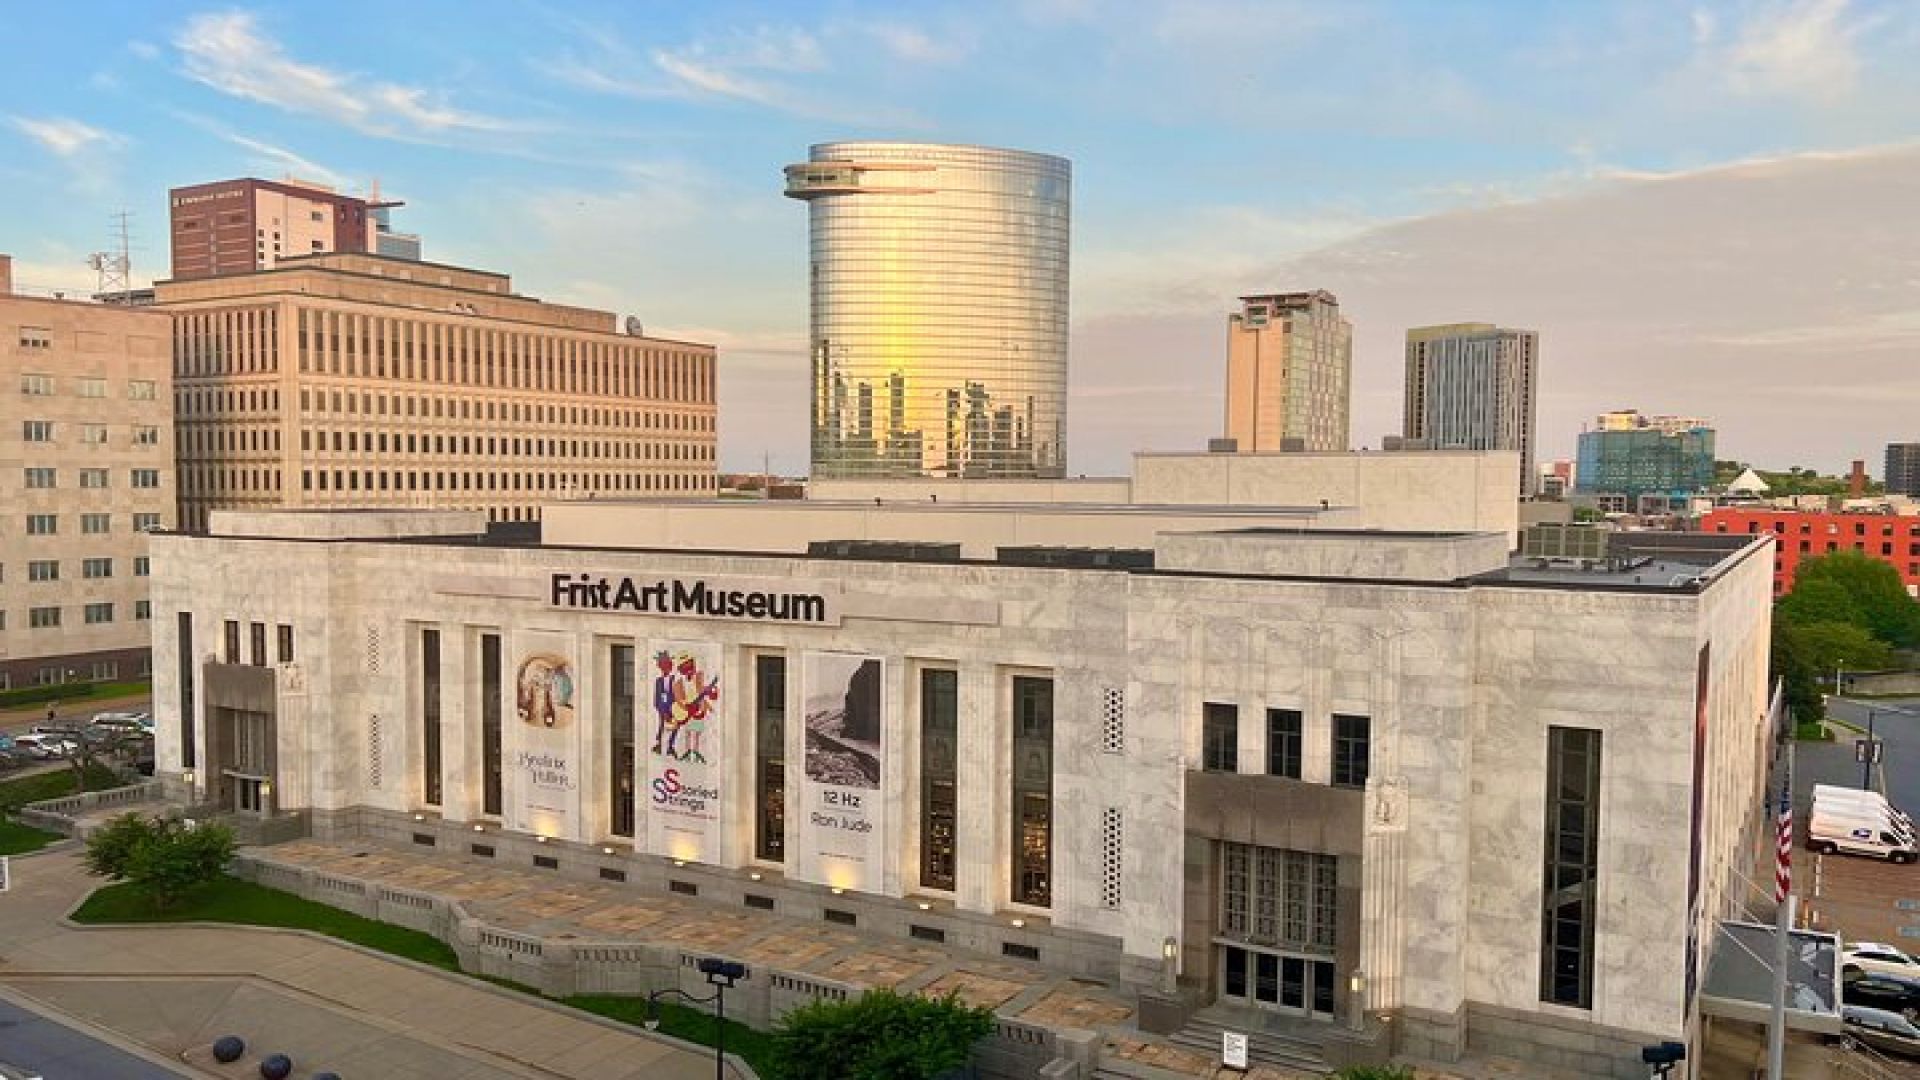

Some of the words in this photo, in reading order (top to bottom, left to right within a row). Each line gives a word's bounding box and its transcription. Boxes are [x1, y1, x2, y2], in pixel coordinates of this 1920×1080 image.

[551, 574, 610, 608] Frist
[613, 577, 668, 611] Art
[672, 580, 825, 621] Museum
